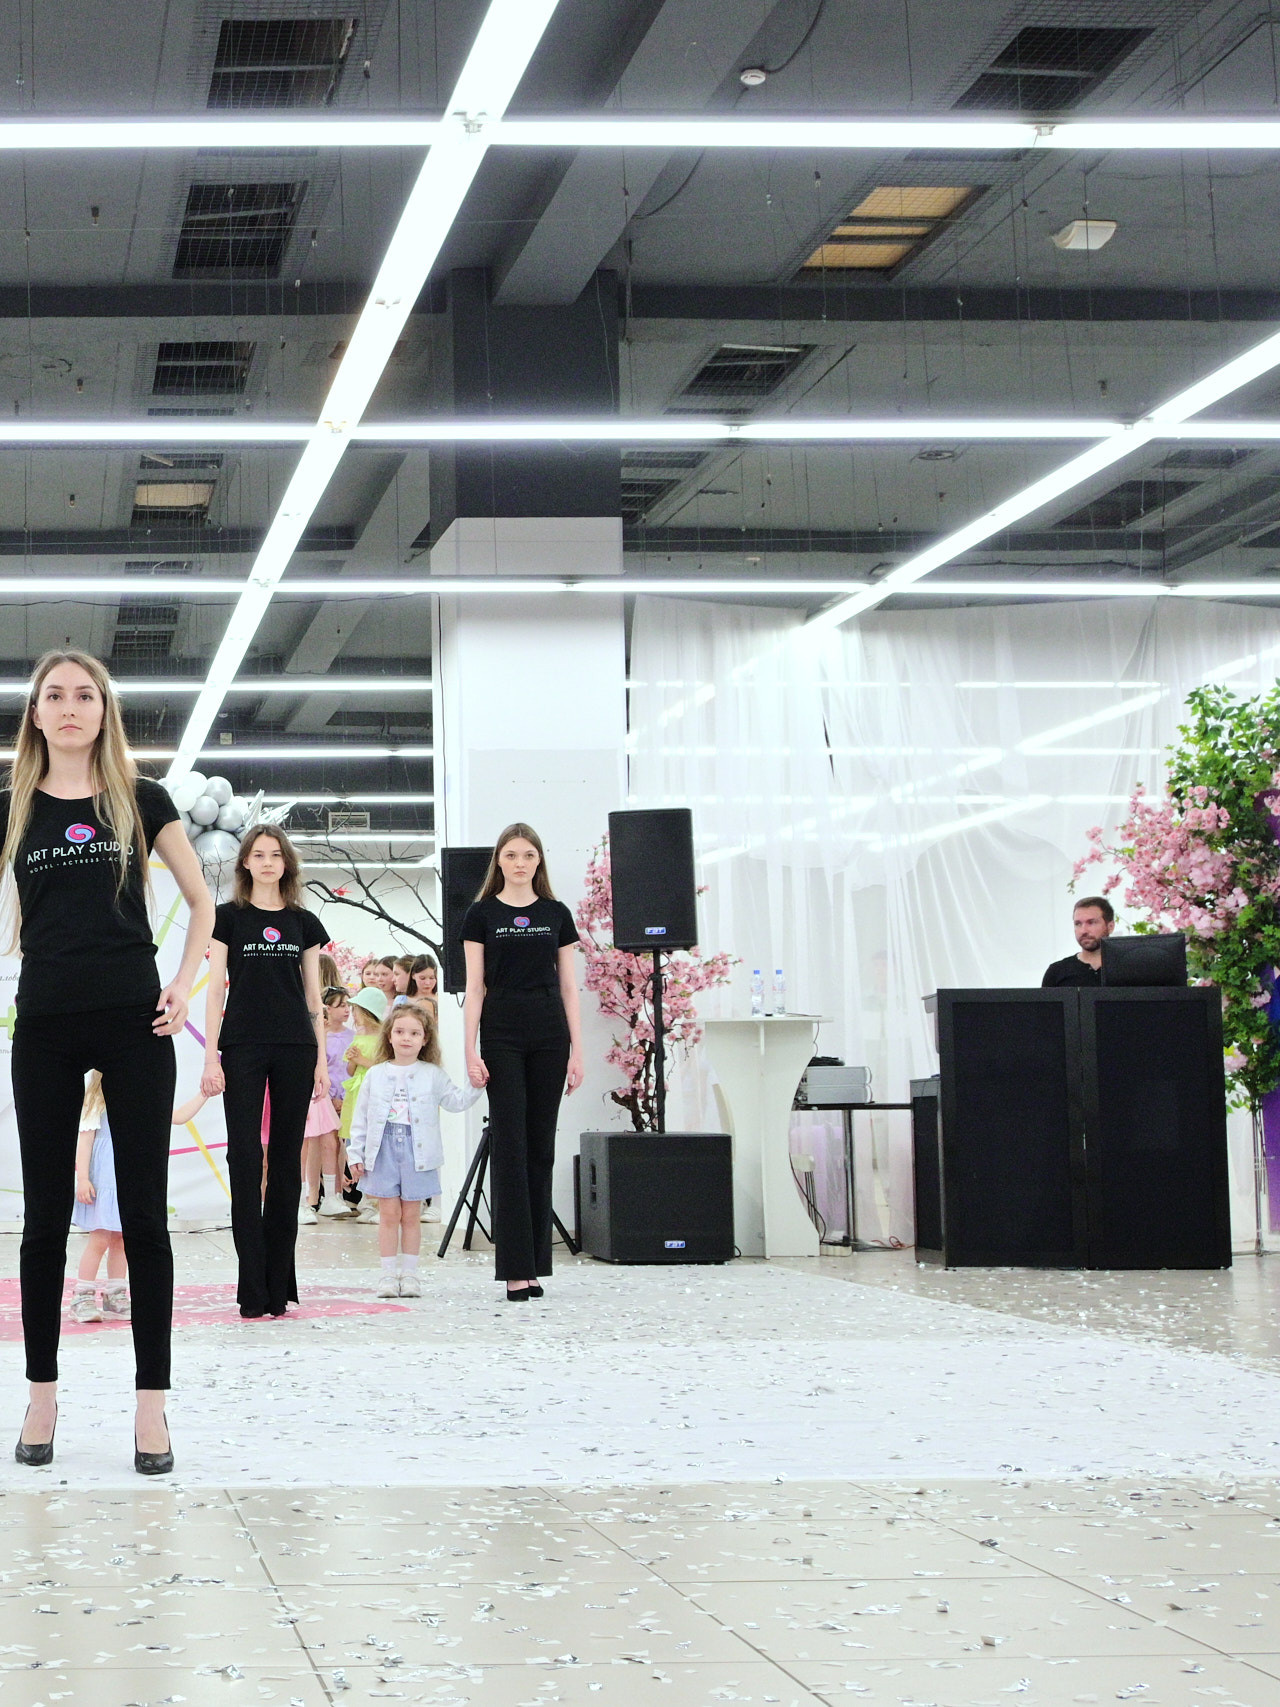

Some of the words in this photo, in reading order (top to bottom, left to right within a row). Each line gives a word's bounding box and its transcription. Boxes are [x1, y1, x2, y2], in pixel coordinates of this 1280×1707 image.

[27, 849, 48, 865] ART
[52, 844, 85, 858] PLAY
[89, 841, 134, 855] STUDO
[277, 944, 299, 952] STUDIO
